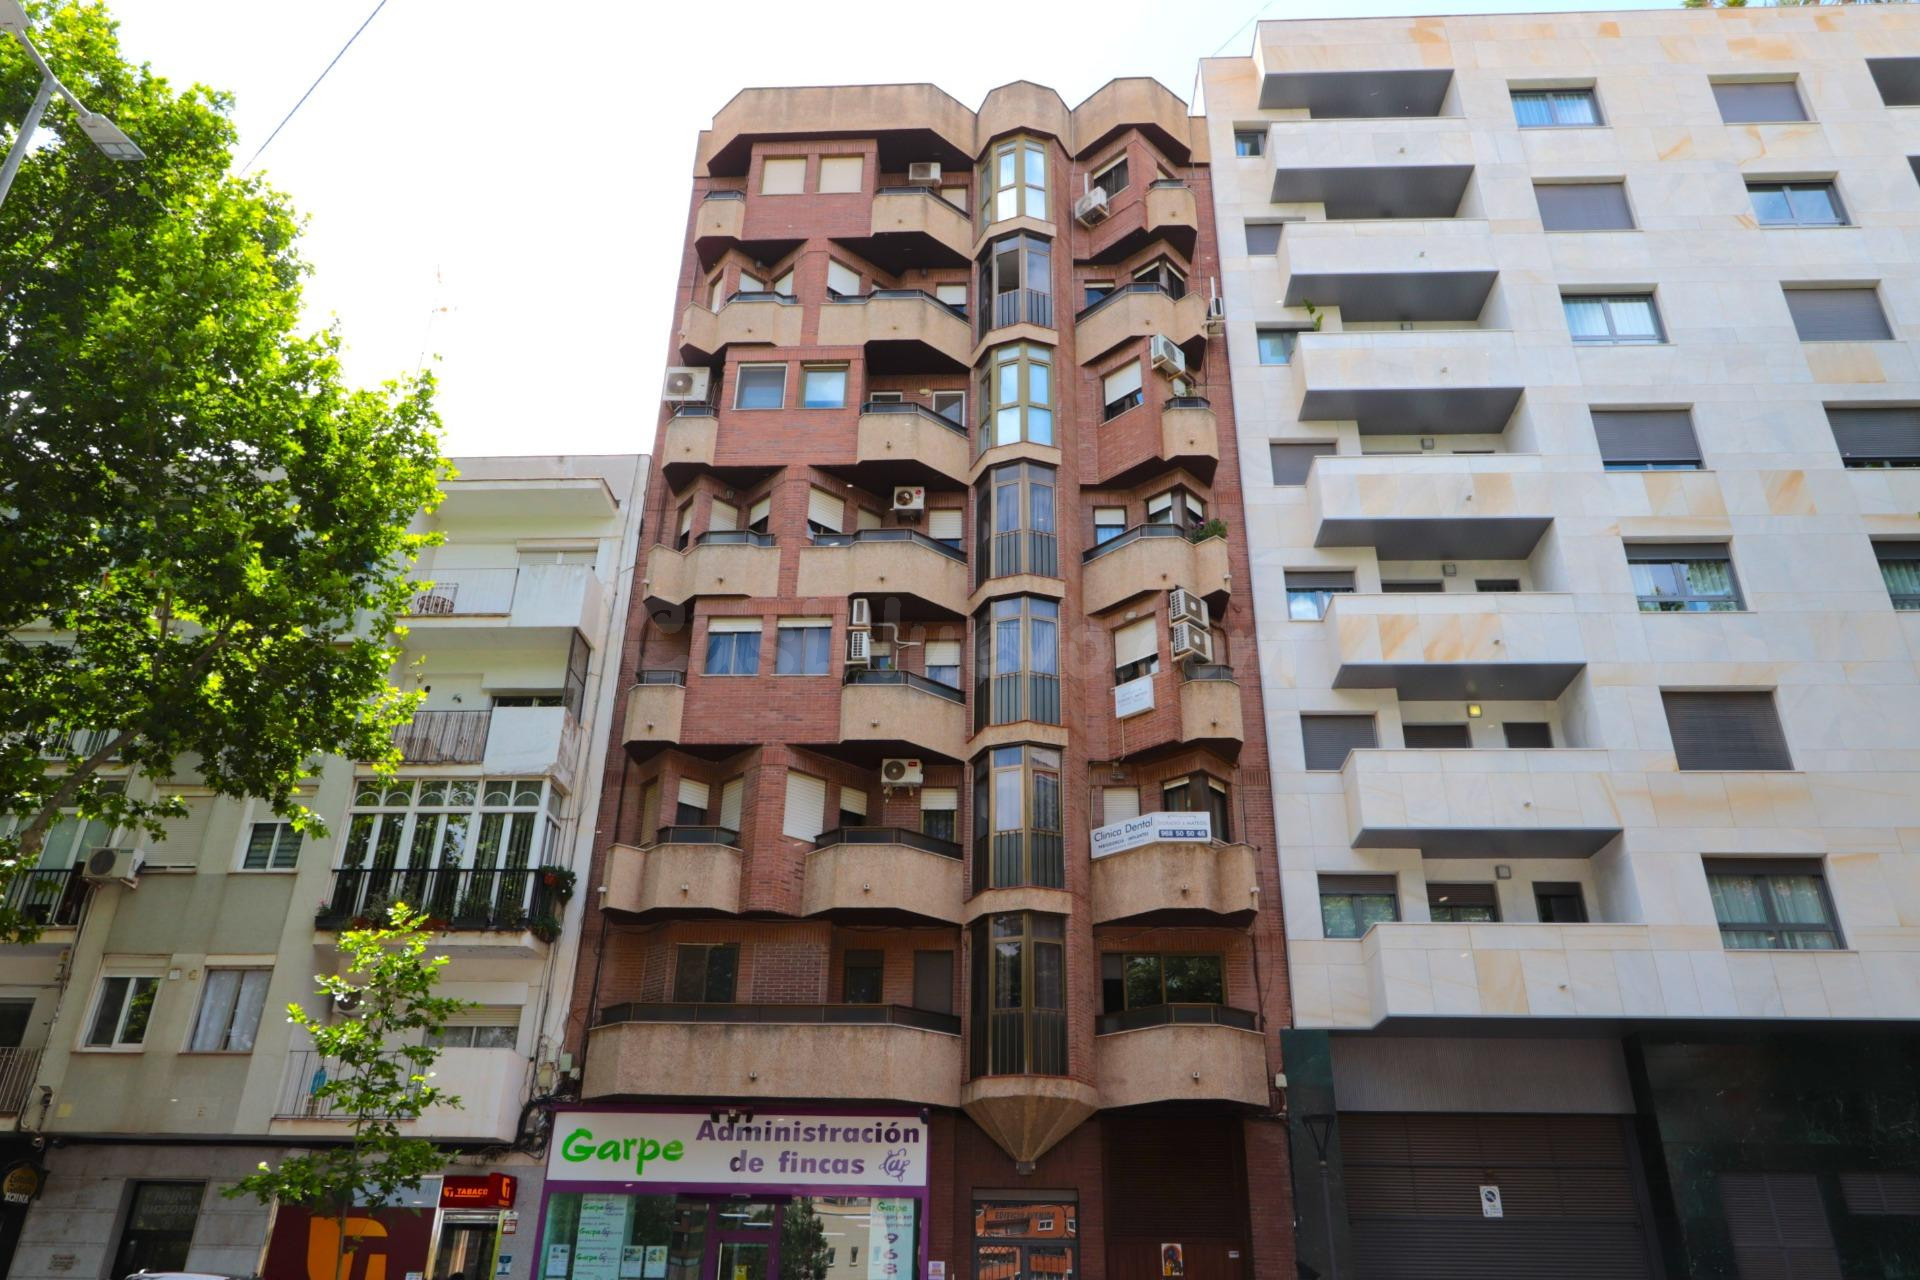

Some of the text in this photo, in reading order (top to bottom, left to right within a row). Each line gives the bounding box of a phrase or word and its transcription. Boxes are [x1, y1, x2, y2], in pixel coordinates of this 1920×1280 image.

[1125, 816, 1153, 834] Dental
[696, 1119, 919, 1144] Administración
[561, 1128, 684, 1175] Garpe
[729, 1150, 764, 1174] de
[778, 1150, 865, 1174] fincas
